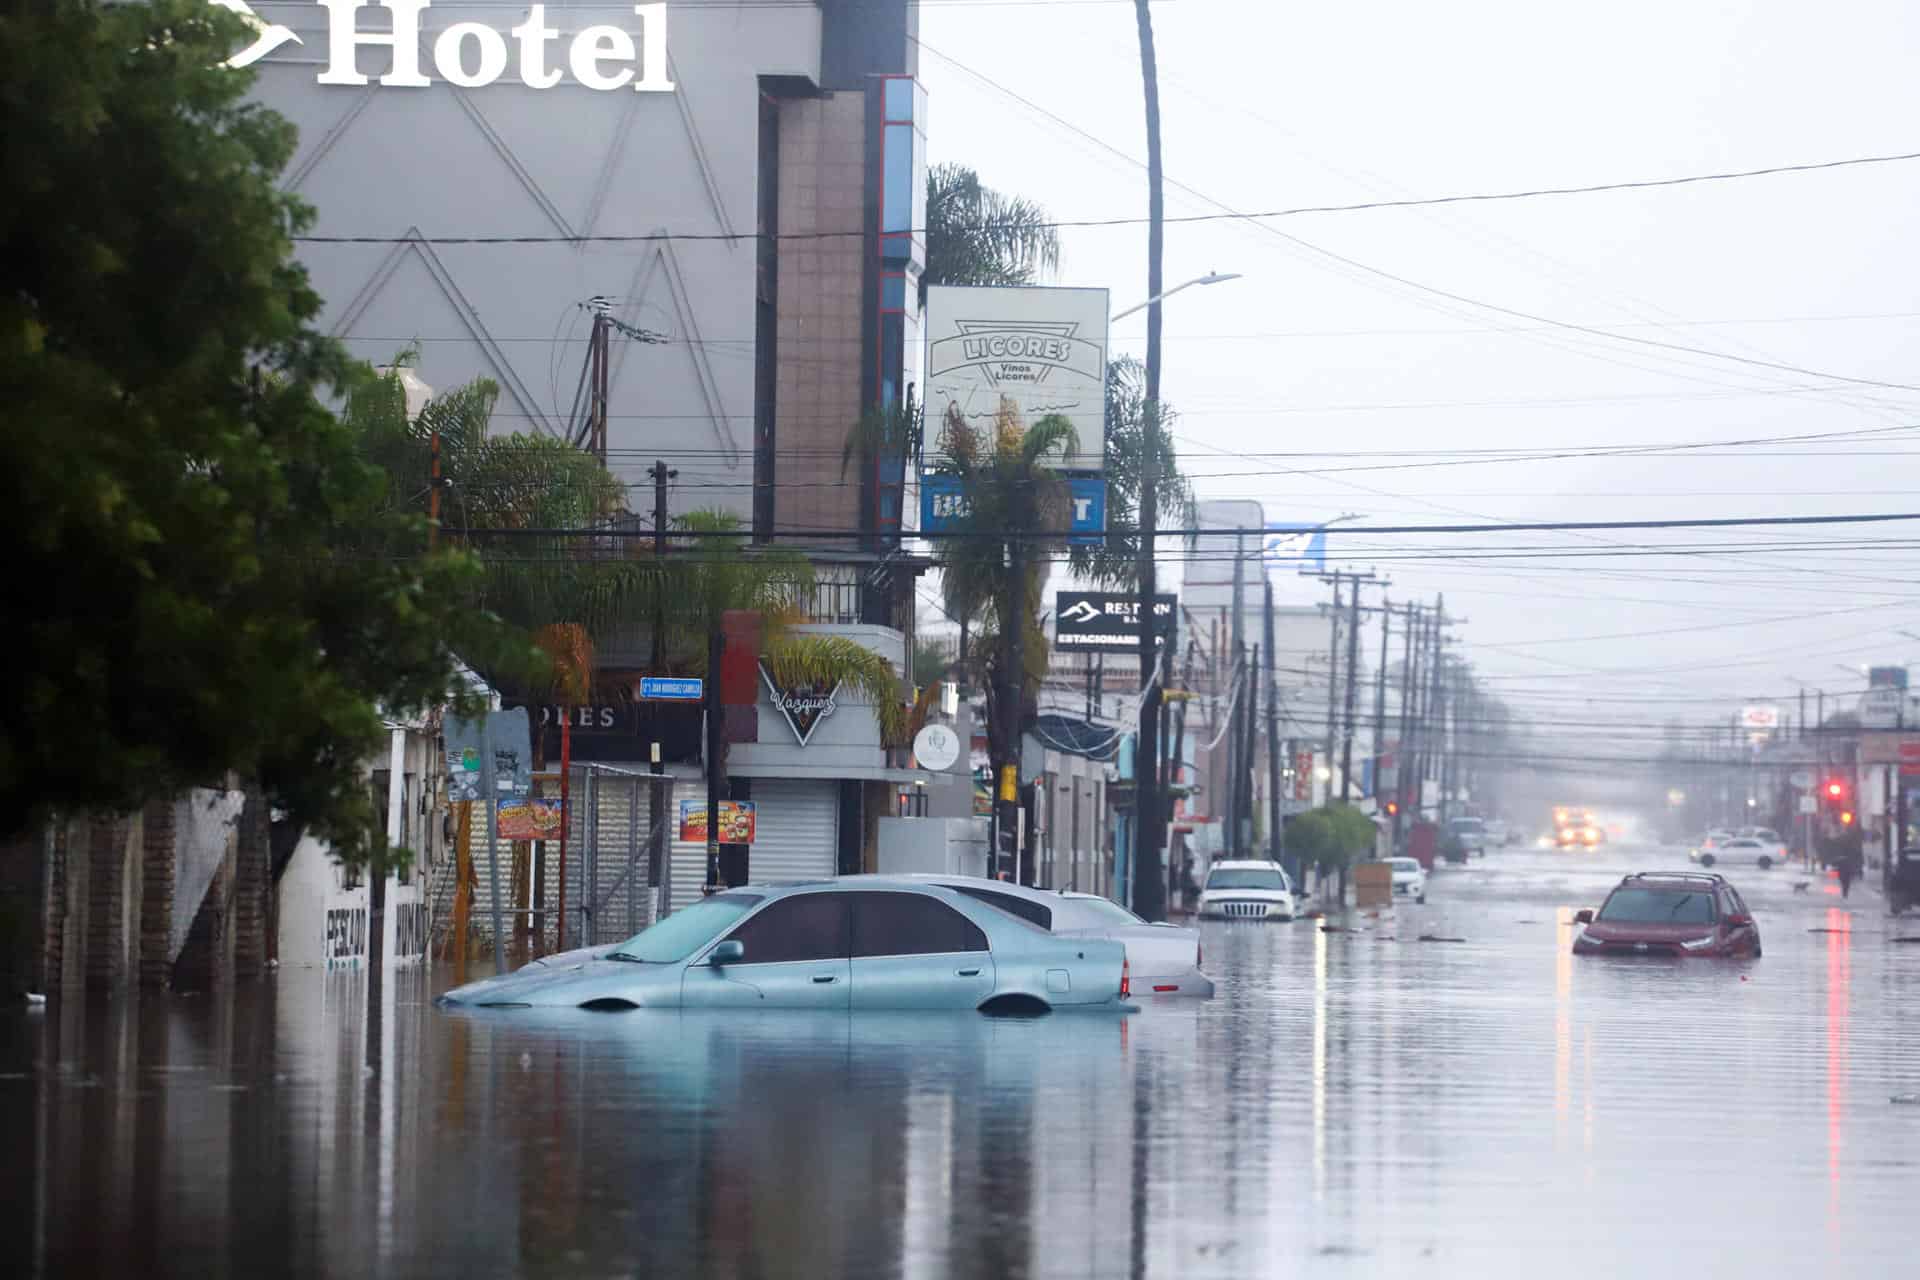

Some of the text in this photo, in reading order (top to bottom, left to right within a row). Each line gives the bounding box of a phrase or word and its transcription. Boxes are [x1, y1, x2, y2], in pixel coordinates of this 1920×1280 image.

[317, 0, 675, 92] Hotel
[963, 336, 1071, 361] LICORES
[996, 373, 1036, 381] Licores
[1001, 364, 1031, 373] Vinos
